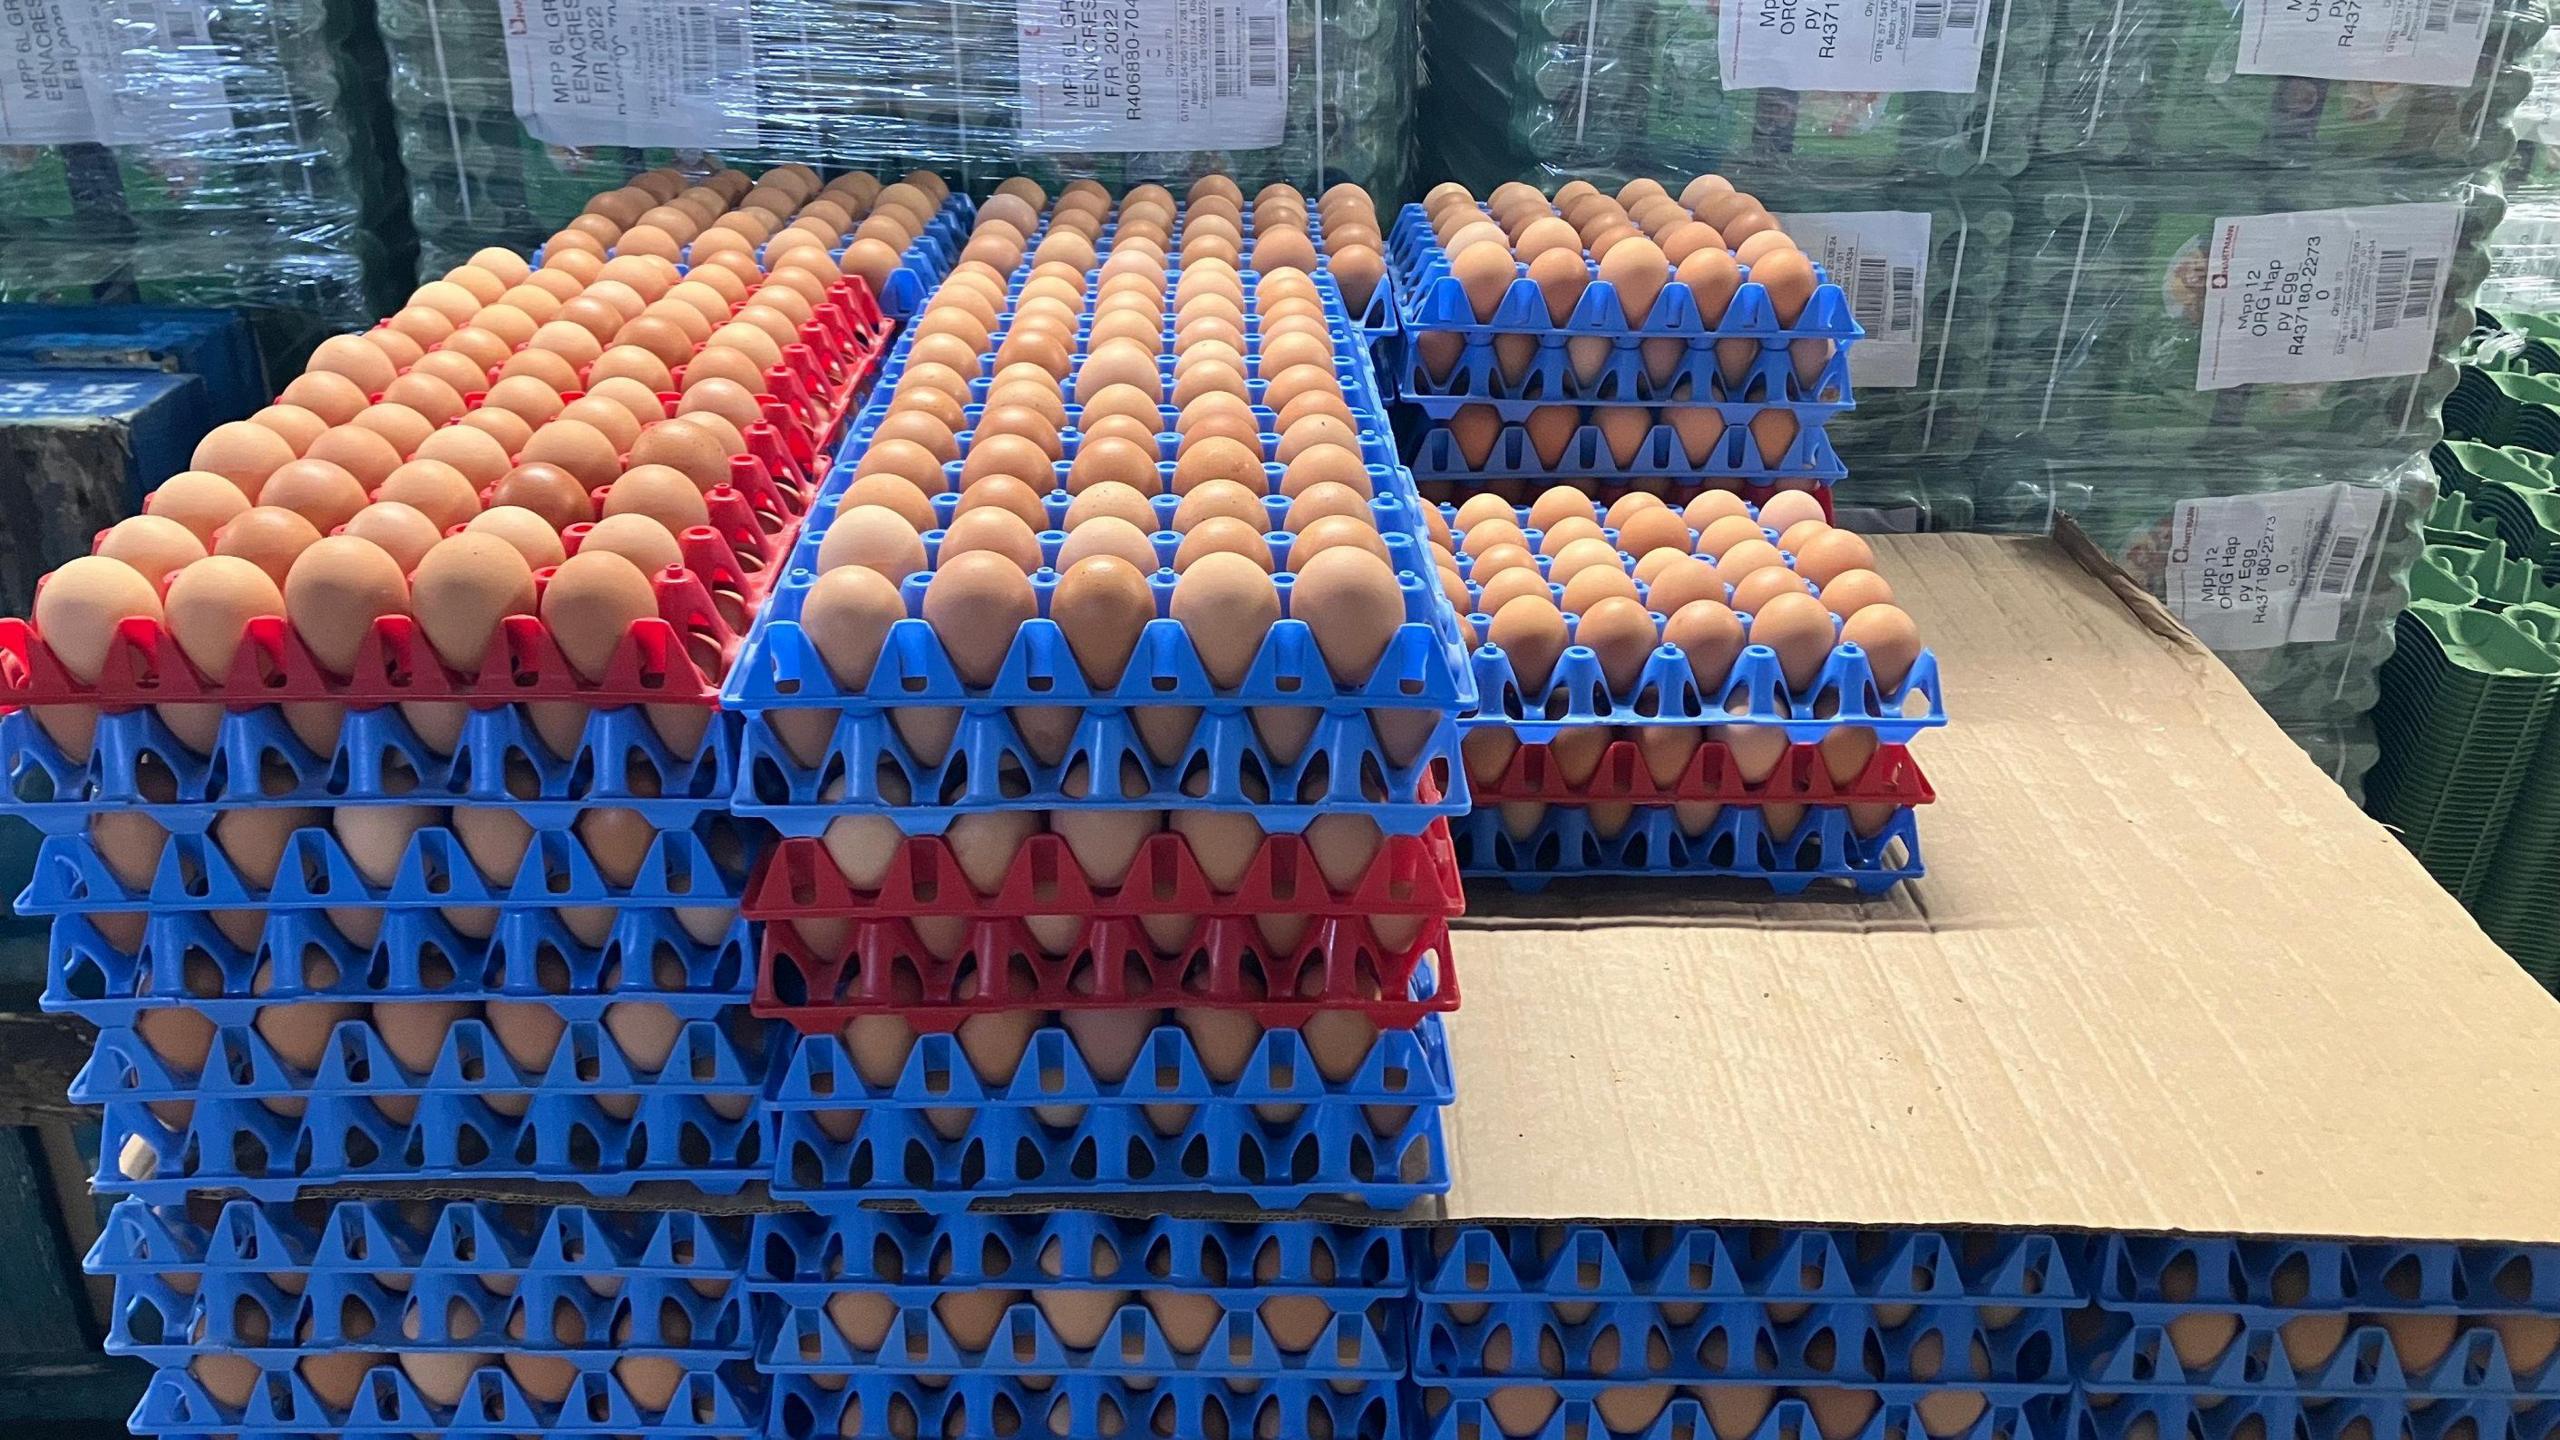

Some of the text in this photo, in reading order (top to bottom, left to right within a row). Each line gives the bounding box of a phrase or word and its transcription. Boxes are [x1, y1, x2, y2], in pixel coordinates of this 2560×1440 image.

[1804, 7, 1822, 30] py
[1818, 3, 1840, 58] R4371
[2337, 1, 2363, 47] R437
[15, 31, 31, 53] 6L
[548, 32, 566, 56] 6L
[17, 59, 41, 100] MPP
[549, 61, 571, 103] MPP
[1062, 64, 1080, 107] MPP
[2238, 269, 2261, 330] Mpp 12
[2251, 259, 2285, 337] ORG Hap
[2288, 236, 2322, 356] R437180-2273
[2277, 312, 2294, 331] py
[2201, 546, 2219, 602] Mpp 12
[2218, 536, 2241, 609] ORG Hap
[2240, 585, 2254, 602] py
